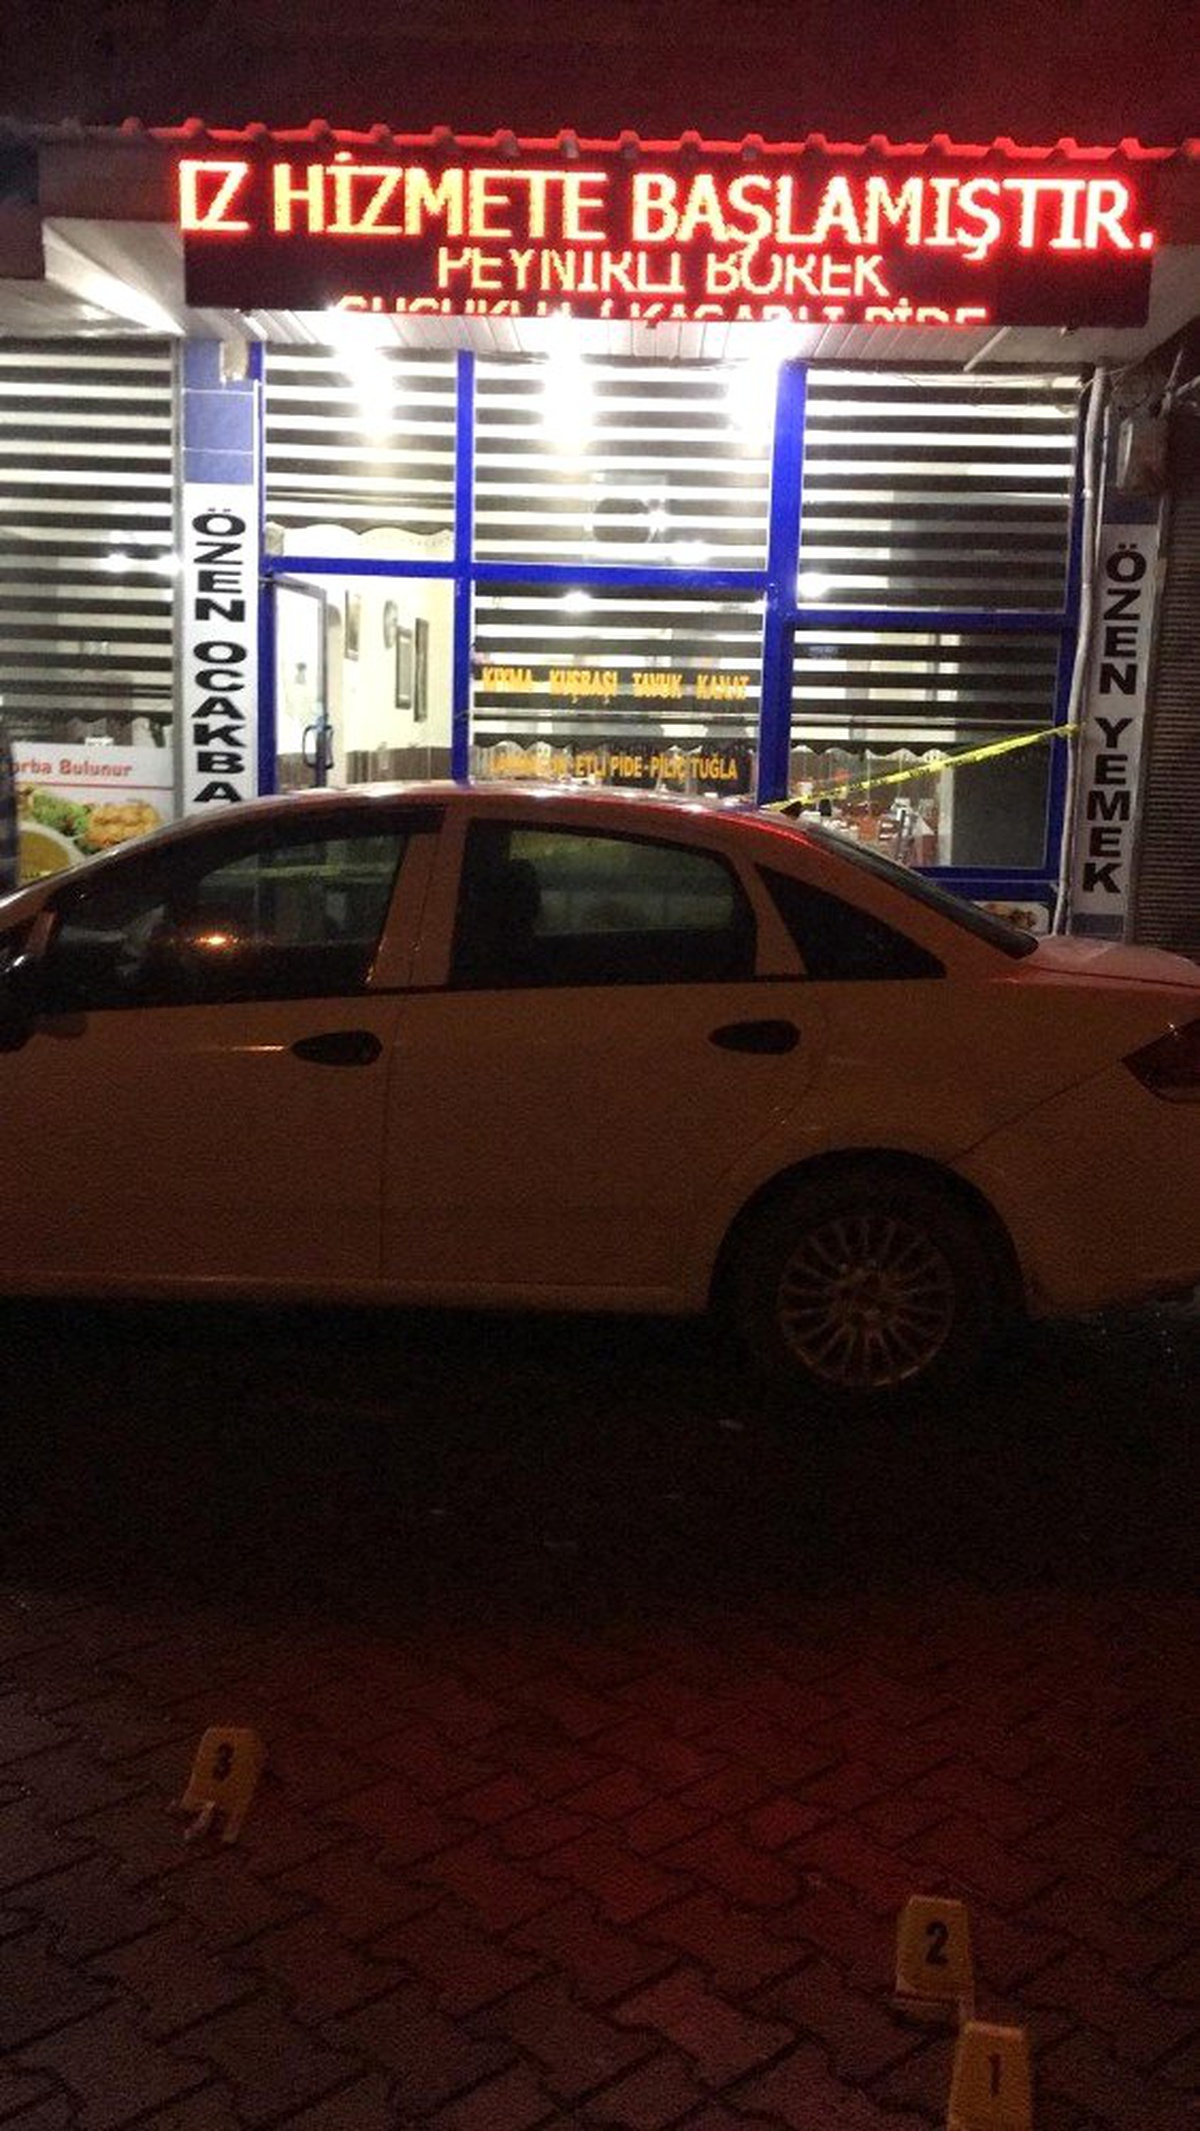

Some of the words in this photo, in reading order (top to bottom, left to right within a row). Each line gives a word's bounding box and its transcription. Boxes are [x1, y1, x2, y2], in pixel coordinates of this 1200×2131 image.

[273, 151, 607, 242] HİZMETE
[631, 171, 1154, 261] BAŞLAMIŞTIR.
[192, 508, 247, 622] ÖZEN
[1099, 543, 1148, 696] ÖZEN
[633, 672, 683, 699] TAVUK
[696, 674, 750, 700] KANAT
[60, 758, 133, 777] Bulunur
[1082, 716, 1133, 895] YEMEK
[212, 1742, 235, 1782] 3
[925, 1920, 949, 1966] 2
[987, 2053, 1002, 2097] 1
